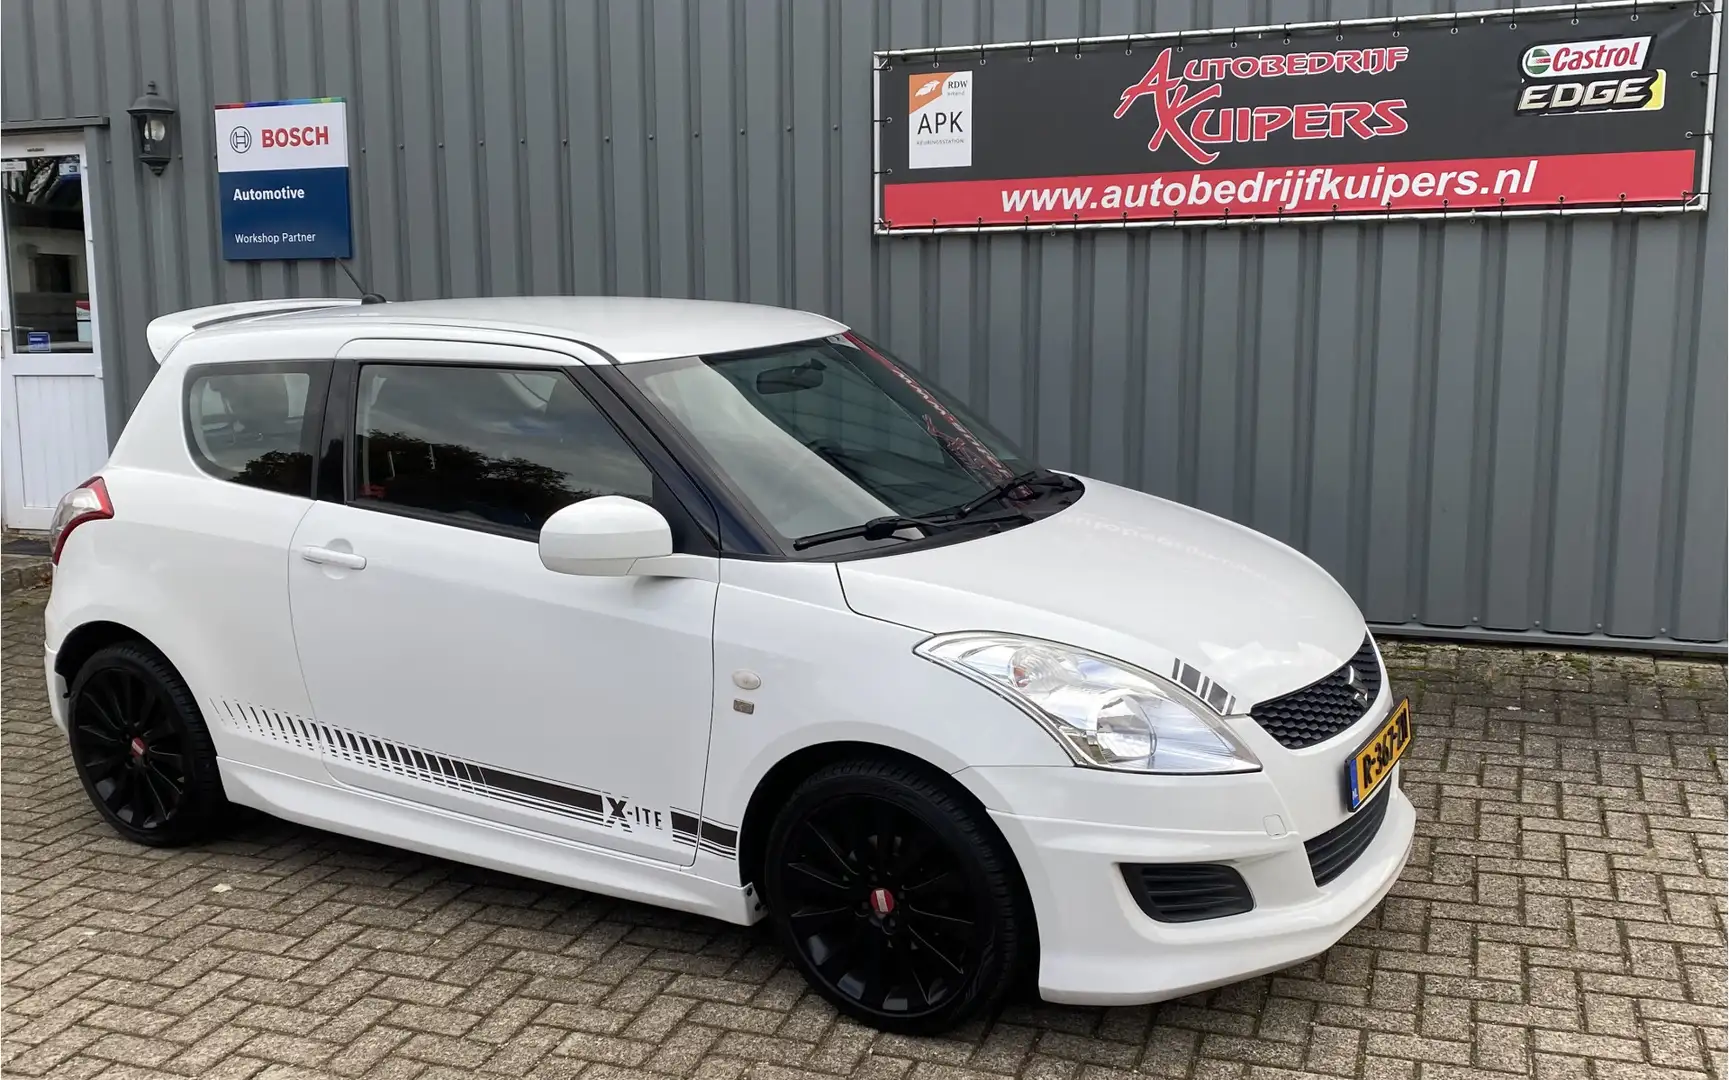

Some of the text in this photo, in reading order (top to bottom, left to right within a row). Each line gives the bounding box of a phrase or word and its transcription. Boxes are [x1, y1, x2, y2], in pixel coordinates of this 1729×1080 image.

[1552, 41, 1640, 72] Castrol
[947, 80, 968, 89] RDW
[1113, 47, 1409, 119] AUTOBEDRIJF
[1517, 76, 1653, 111] EDGE
[917, 111, 963, 135] APK
[1148, 83, 1408, 165] KUIPERS
[261, 126, 329, 148] BOSCH
[233, 186, 305, 201] Automotive
[1001, 160, 1538, 211] www.autobedrijfkuipers.nl
[234, 232, 316, 245] Workshop Partner
